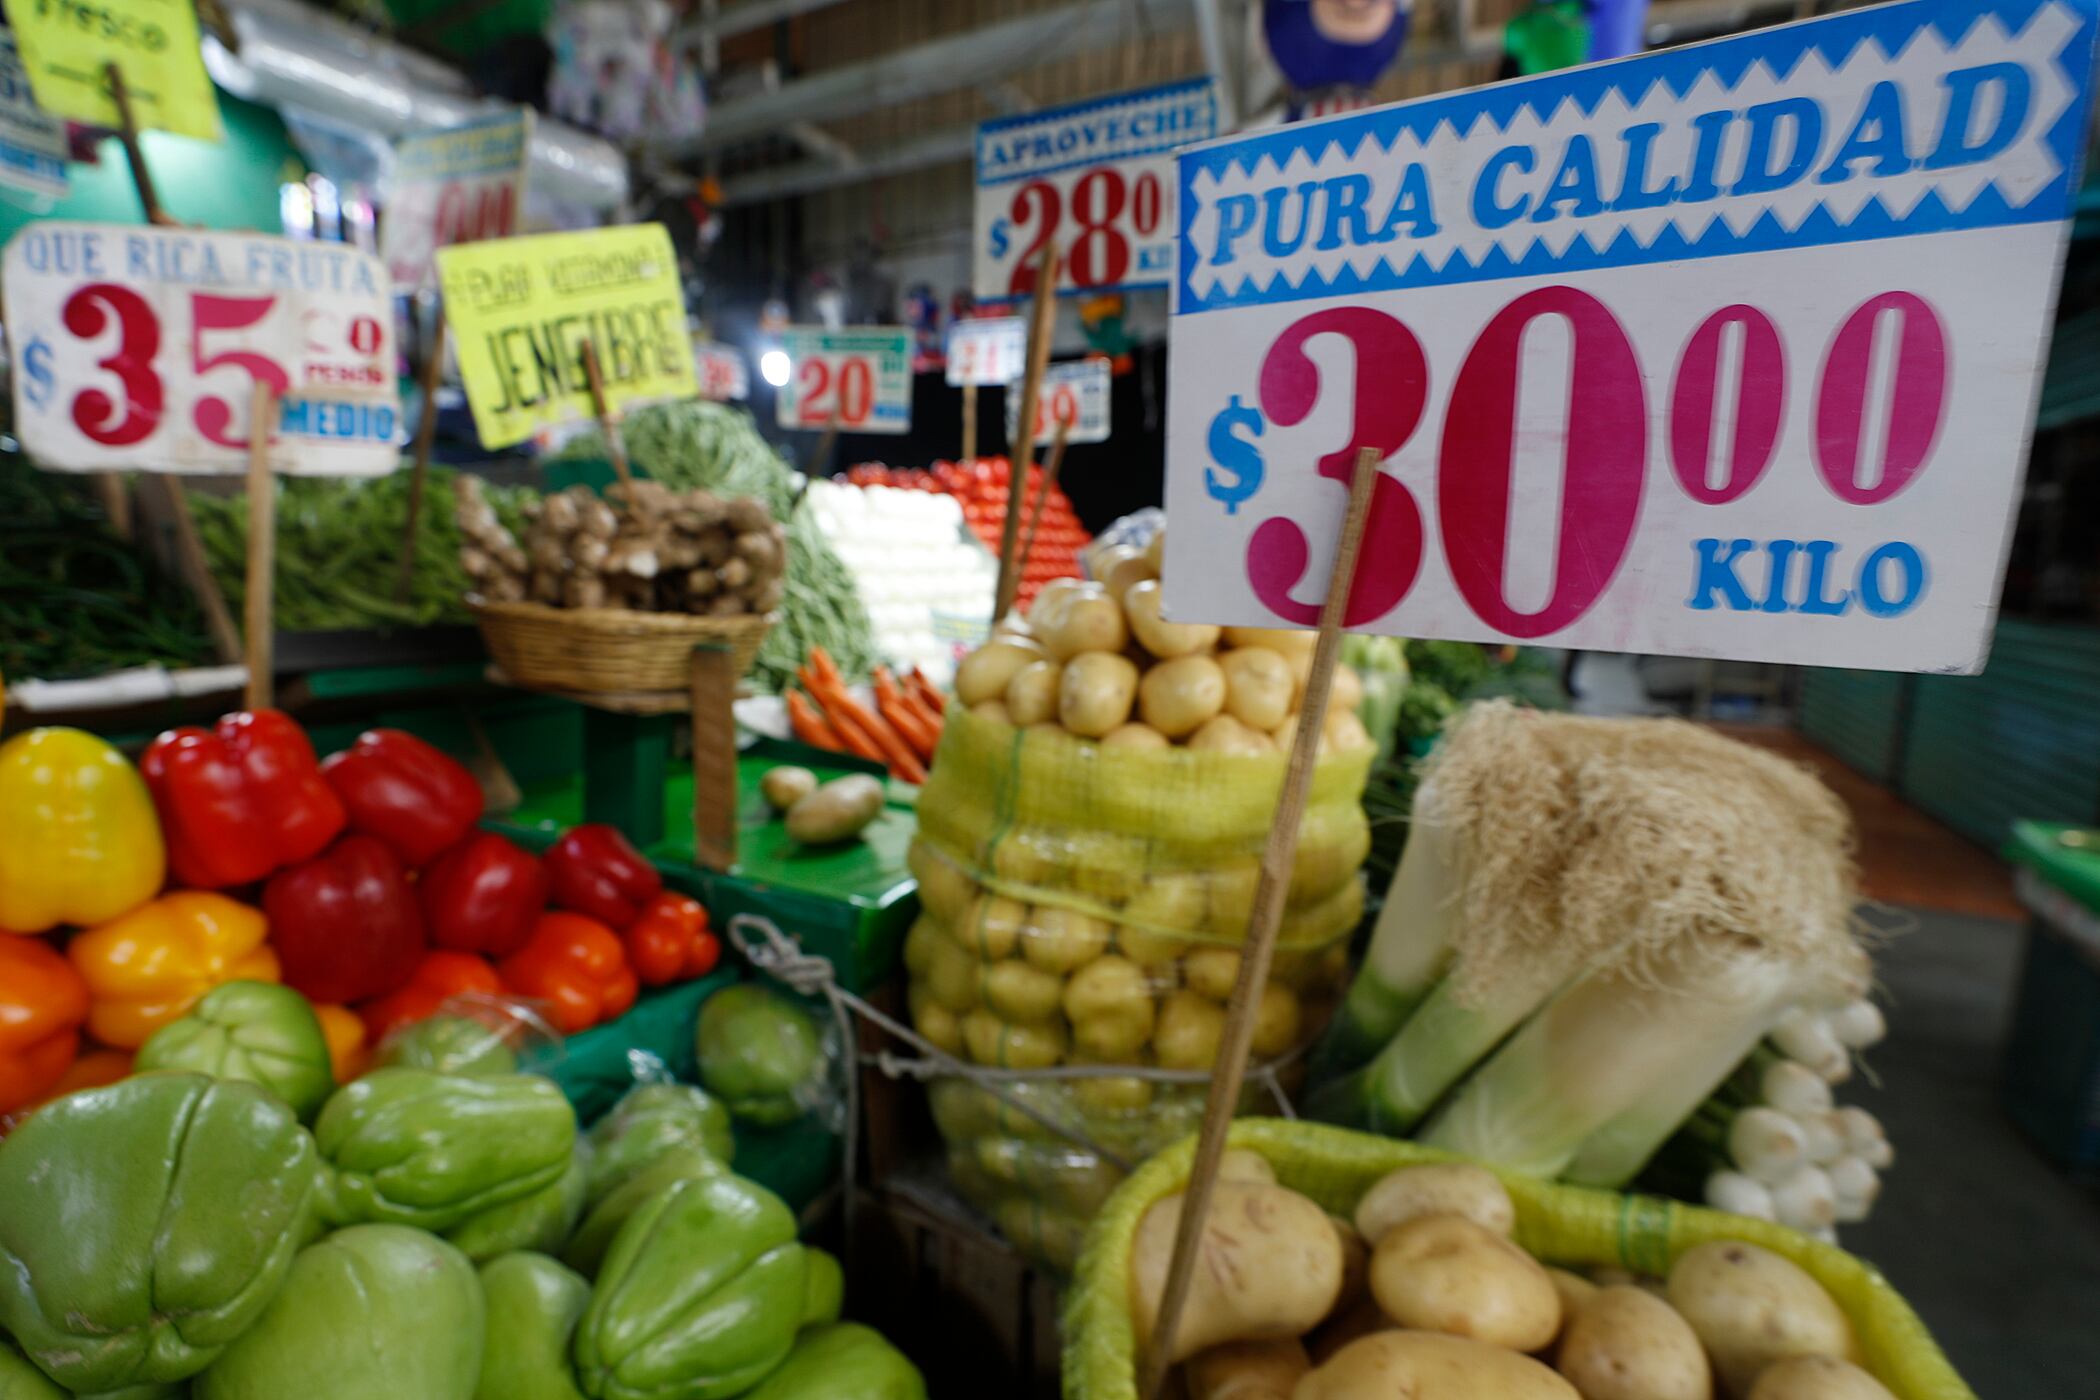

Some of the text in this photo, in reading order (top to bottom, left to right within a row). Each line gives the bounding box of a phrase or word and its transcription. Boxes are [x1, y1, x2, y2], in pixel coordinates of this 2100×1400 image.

[992, 104, 1198, 166] APROVECHE
[1208, 60, 2038, 268] PURA CALIDAD
[24, 230, 378, 296] QUE RICA FRUTA
[485, 298, 684, 414] JENGIBRE
[280, 398, 396, 440] MEDIO
[1688, 538, 1930, 619] KILO
